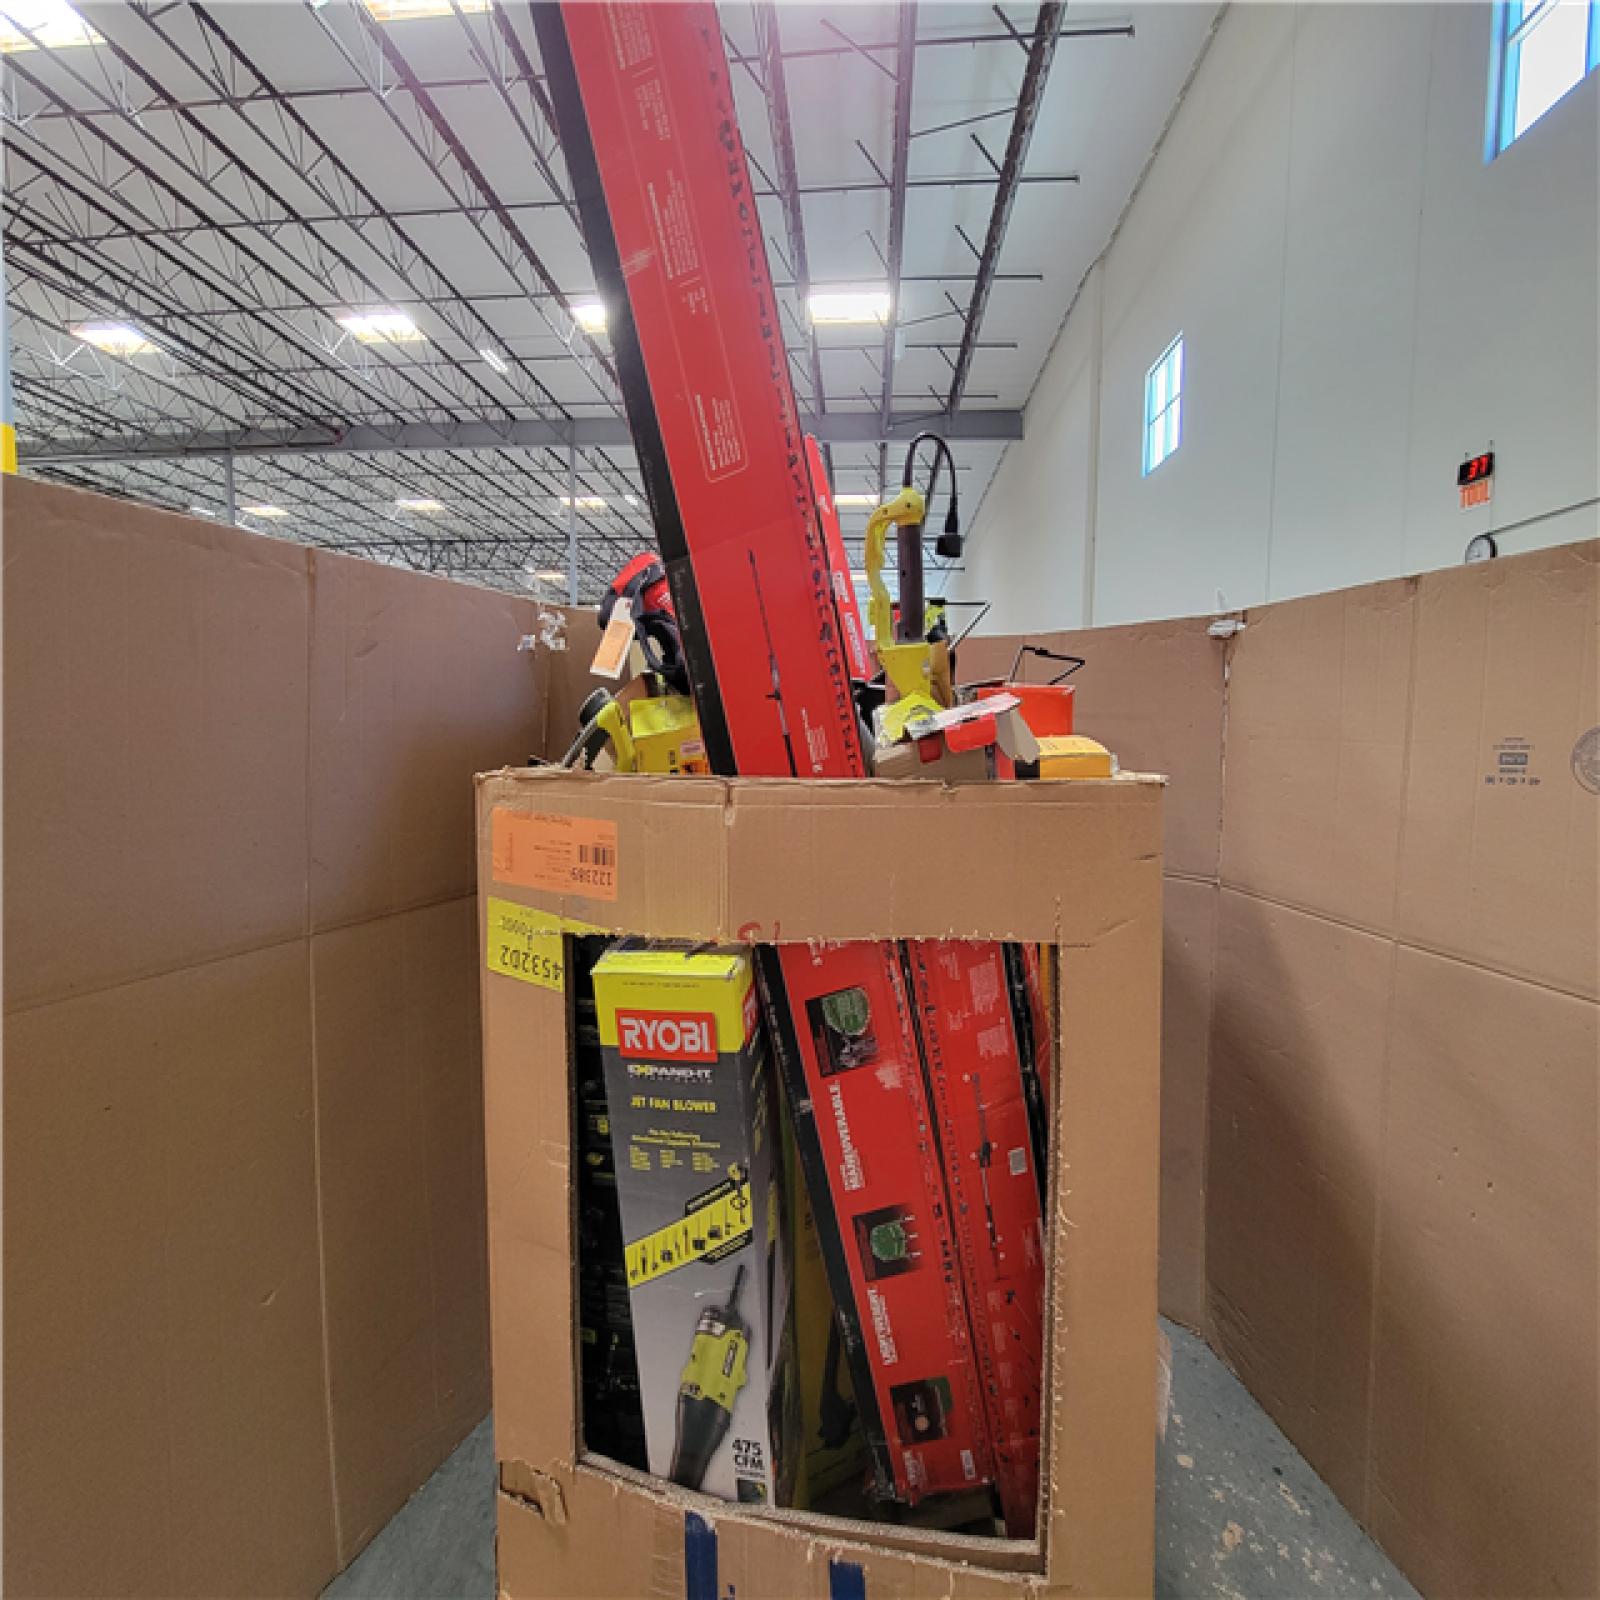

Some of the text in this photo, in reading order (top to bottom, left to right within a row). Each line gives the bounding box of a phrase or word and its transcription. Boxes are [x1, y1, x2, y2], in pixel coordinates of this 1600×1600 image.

[620, 1016, 712, 1053] RYOBI
[650, 1097, 671, 1110] FAN
[672, 1099, 717, 1114] BLOWER
[732, 1438, 763, 1455] 475
[734, 1455, 766, 1471] CFM
